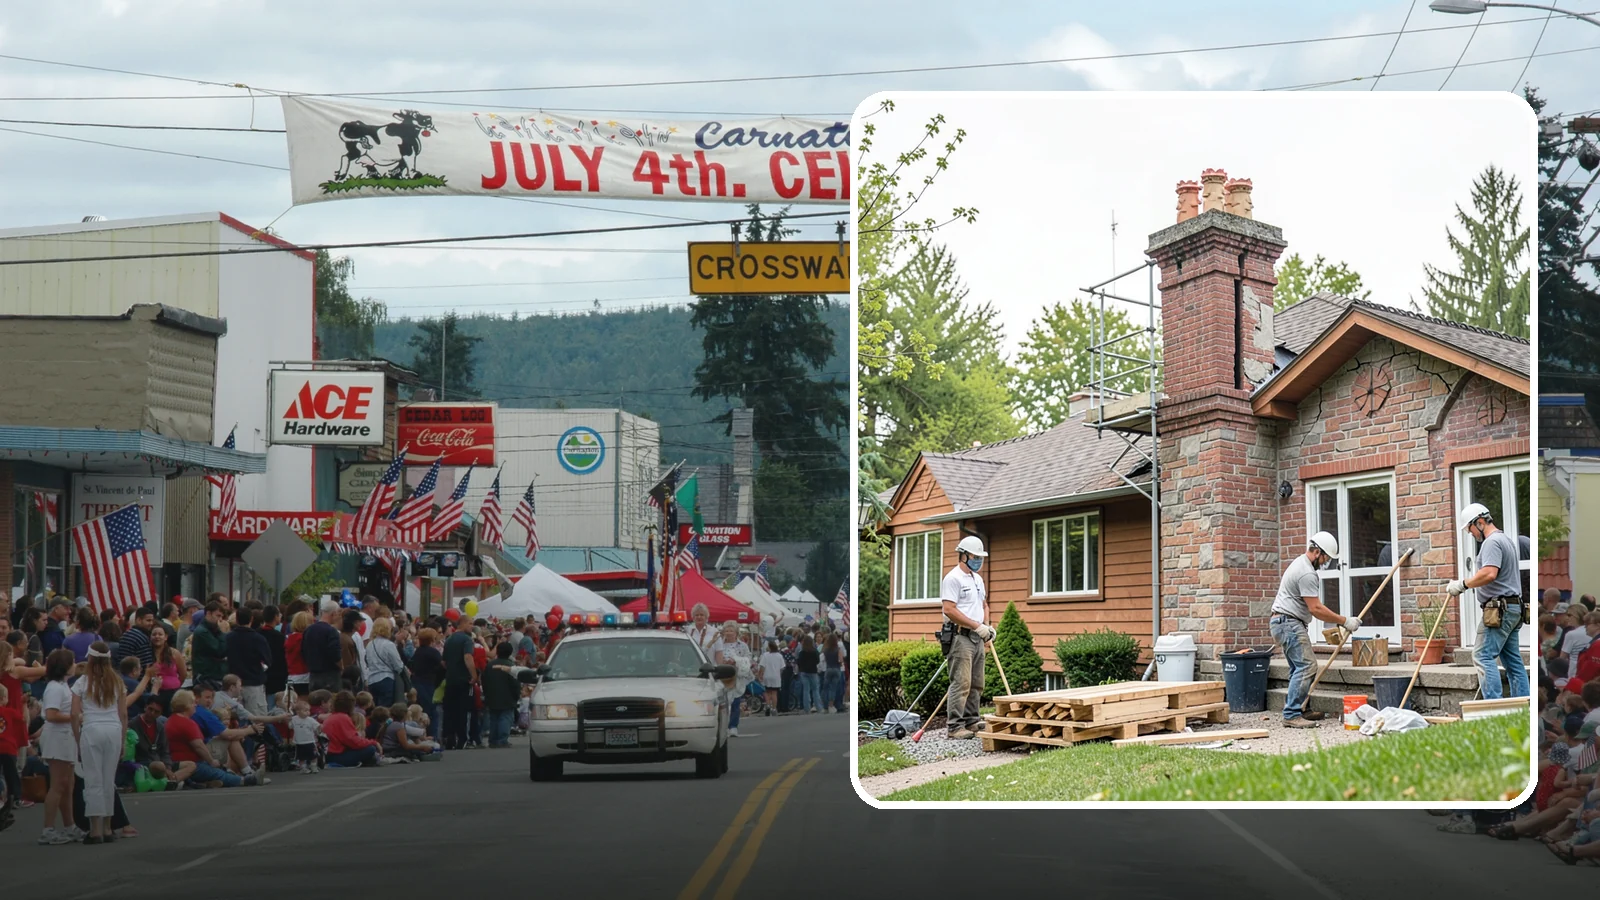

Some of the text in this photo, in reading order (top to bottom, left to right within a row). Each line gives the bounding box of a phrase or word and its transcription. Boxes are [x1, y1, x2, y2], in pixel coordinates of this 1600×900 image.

[481, 140, 605, 193] JULY
[632, 150, 746, 197] 4th.
[697, 254, 850, 280] CROSSWA
[282, 380, 373, 419] ACE
[405, 409, 485, 422] CEDAR LOG
[283, 421, 370, 436] Hardware
[416, 428, 477, 447] Coca-Cola
[353, 467, 384, 480] Simpl
[83, 485, 155, 495] St. Vincent de Paul
[81, 503, 154, 522] THRT
[688, 526, 742, 535] CRNATION
[699, 535, 730, 543] GLASS
